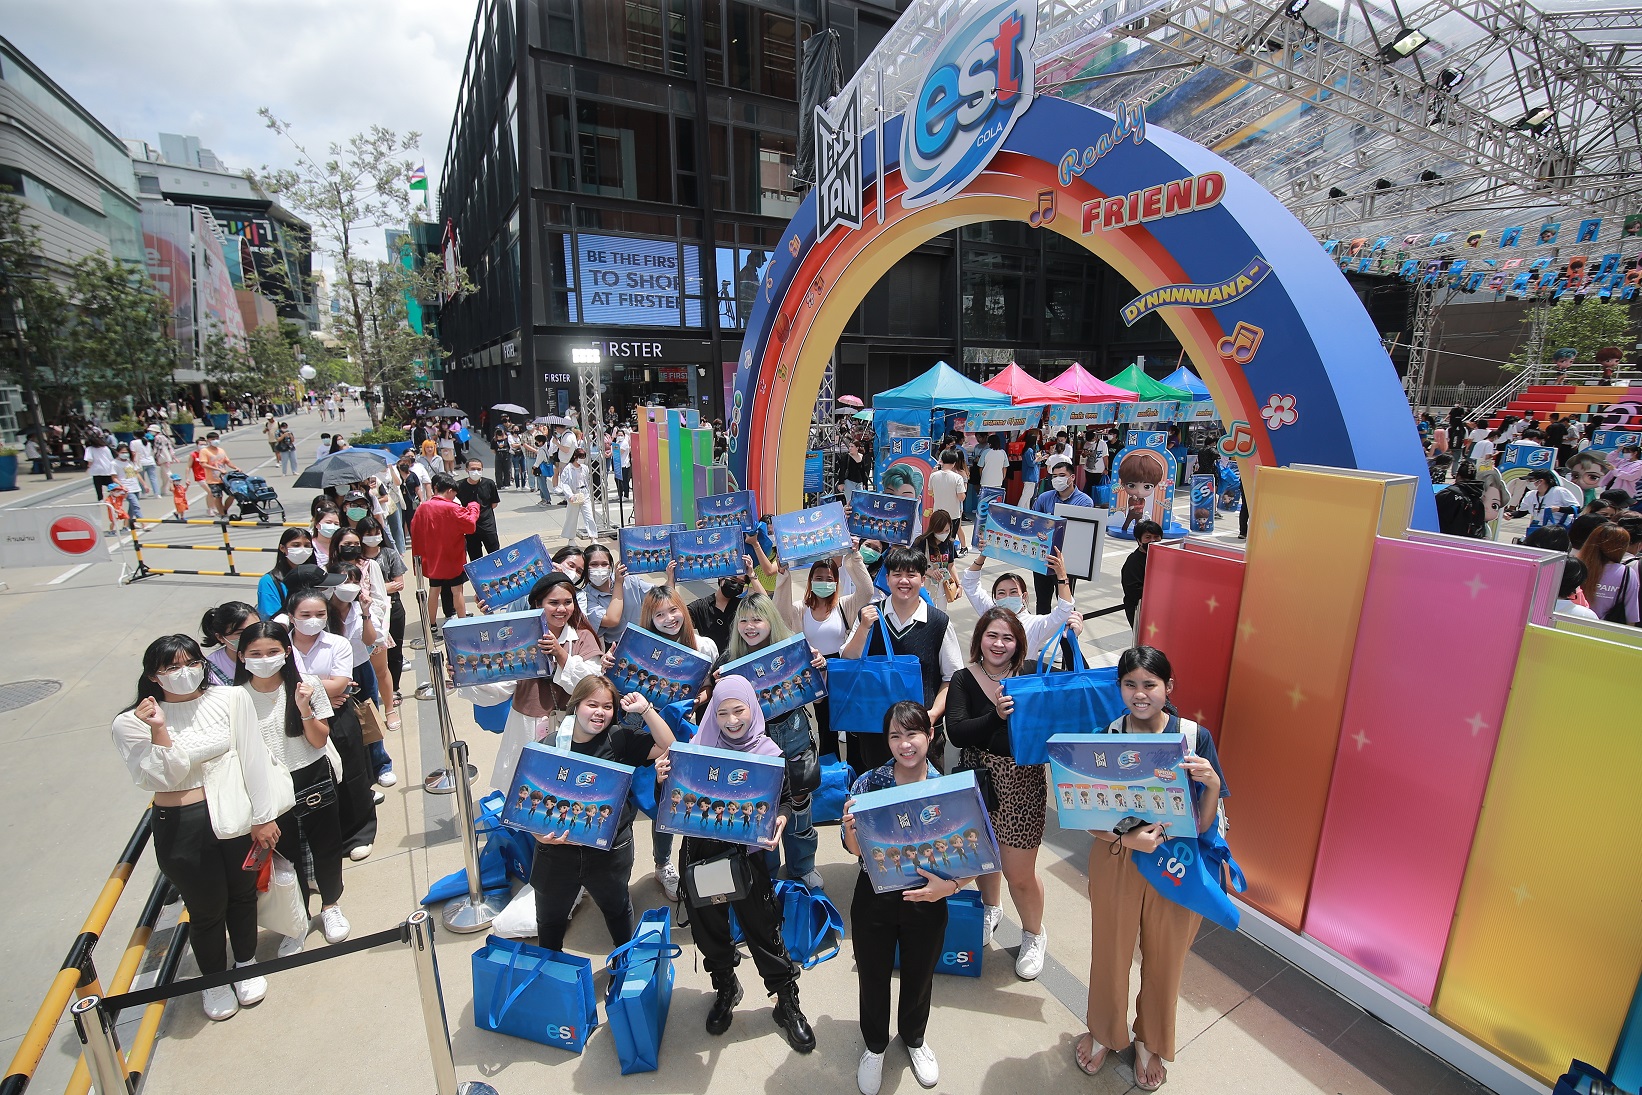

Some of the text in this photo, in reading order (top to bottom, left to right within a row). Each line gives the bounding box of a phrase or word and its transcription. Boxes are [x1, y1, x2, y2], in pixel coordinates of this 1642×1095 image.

[915, 11, 1023, 157] est
[976, 121, 1003, 148] COLA
[1057, 100, 1147, 187] Ready
[821, 154, 856, 227] TAN
[1082, 171, 1226, 235] FRIEND
[587, 250, 679, 268] BE THE FIRS
[588, 269, 620, 287] TO
[590, 291, 613, 306] AT
[1597, 583, 1620, 592] PAIN
[1162, 841, 1194, 887] est
[942, 950, 975, 966] est
[546, 1023, 577, 1040] est
